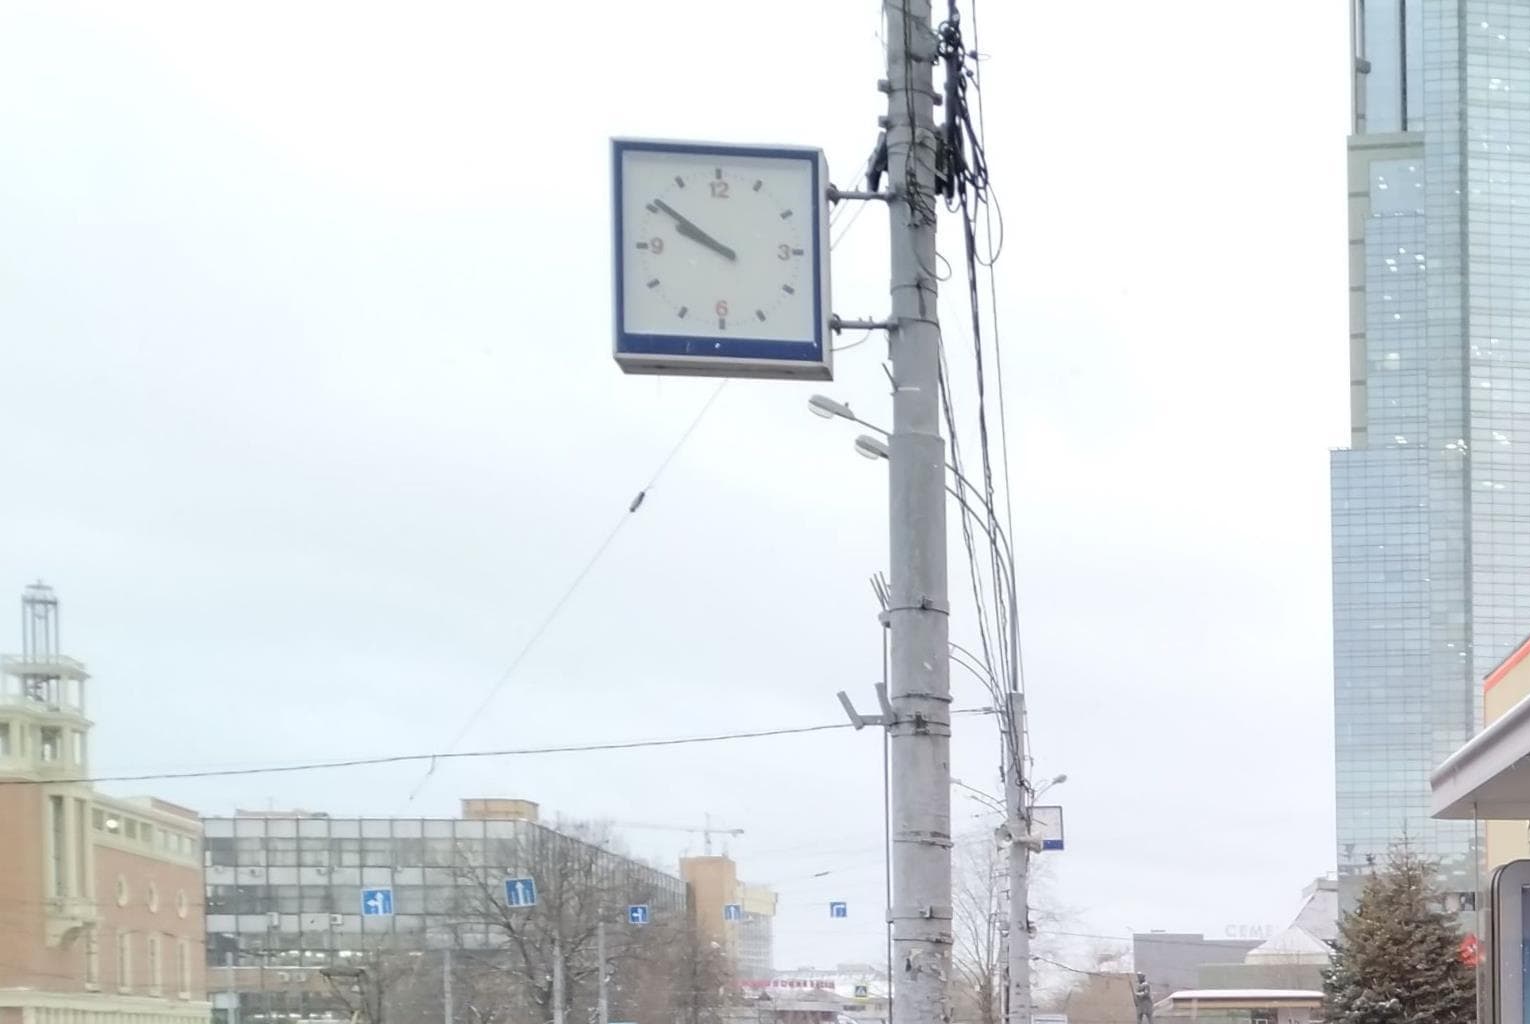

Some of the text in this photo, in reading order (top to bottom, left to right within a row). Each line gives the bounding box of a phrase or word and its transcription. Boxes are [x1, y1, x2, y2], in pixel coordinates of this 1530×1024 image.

[710, 181, 730, 199] 12
[650, 237, 665, 255] 9
[777, 244, 791, 261] 3
[715, 300, 729, 317] 6
